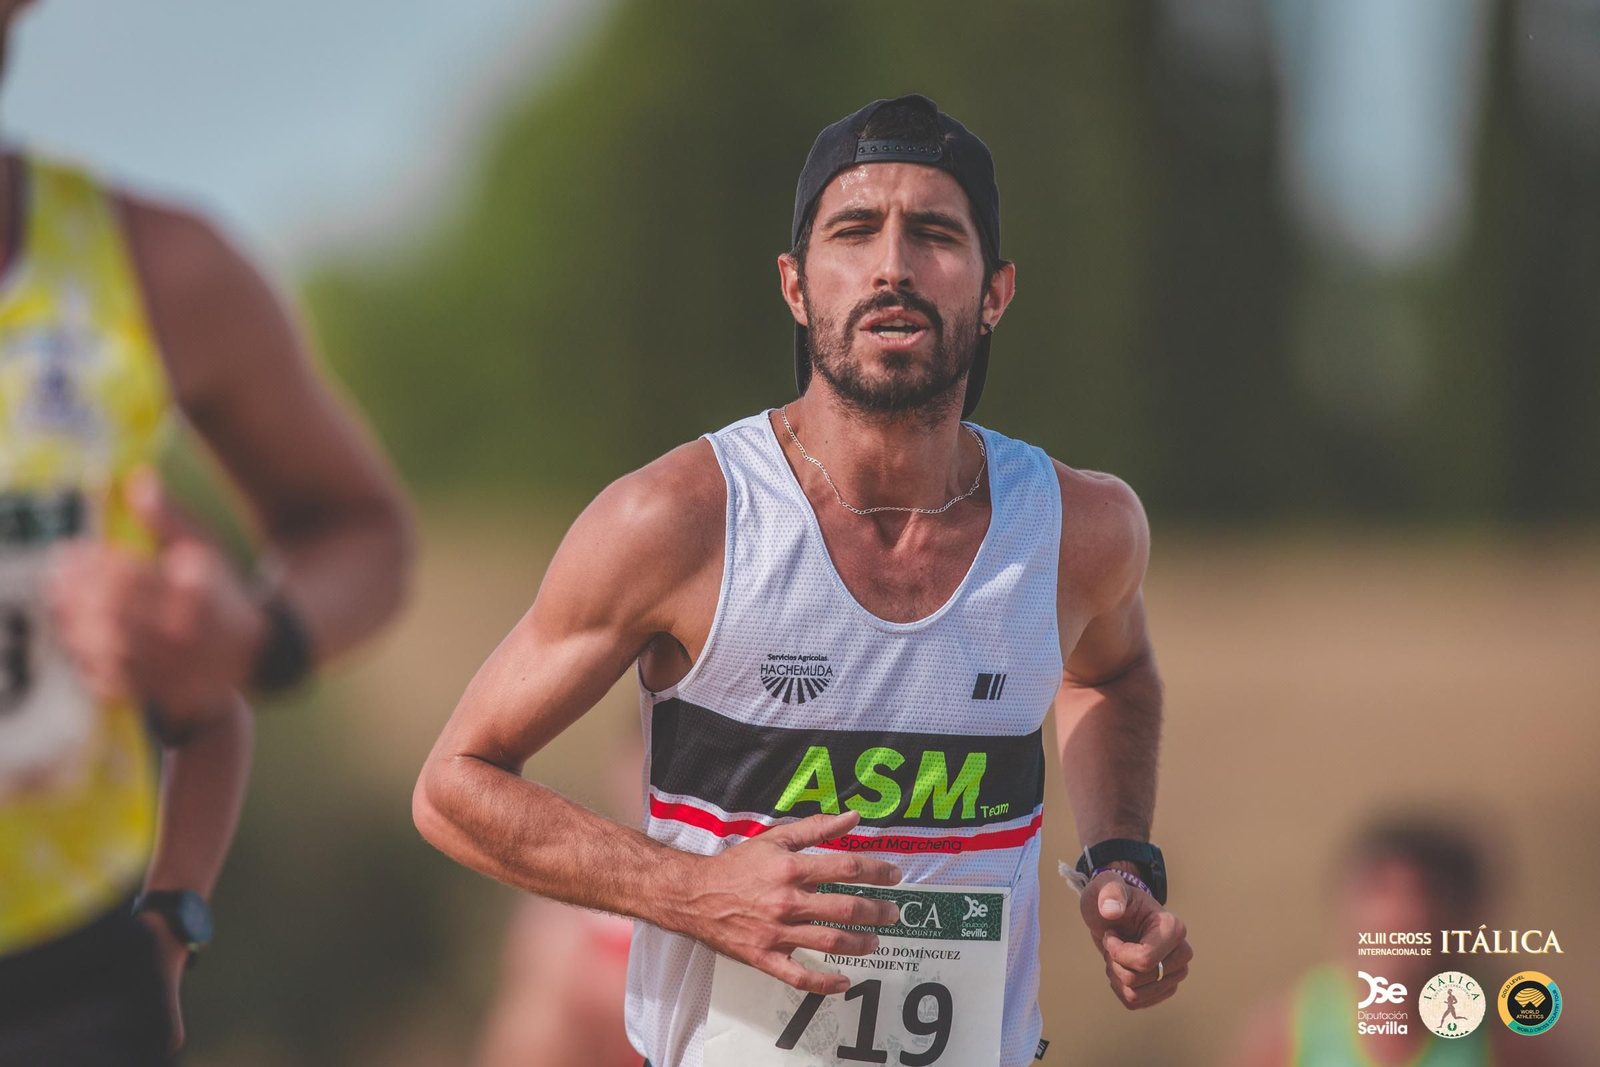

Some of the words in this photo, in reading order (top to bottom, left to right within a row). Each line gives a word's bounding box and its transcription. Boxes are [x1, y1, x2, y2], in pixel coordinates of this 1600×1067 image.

[768, 653, 797, 661] Servicios
[760, 664, 833, 677] HACHEMUDA
[775, 746, 987, 819] ASM
[980, 802, 1009, 818] Team
[839, 836, 884, 851] Sport
[886, 837, 962, 851] Marchena
[879, 926, 904, 935] CROSS
[906, 929, 942, 937] COUNTRY
[961, 928, 987, 938] Sevilla
[892, 946, 961, 961] DOMÍNGUEZ
[823, 953, 920, 972] INDEPENDIENTE
